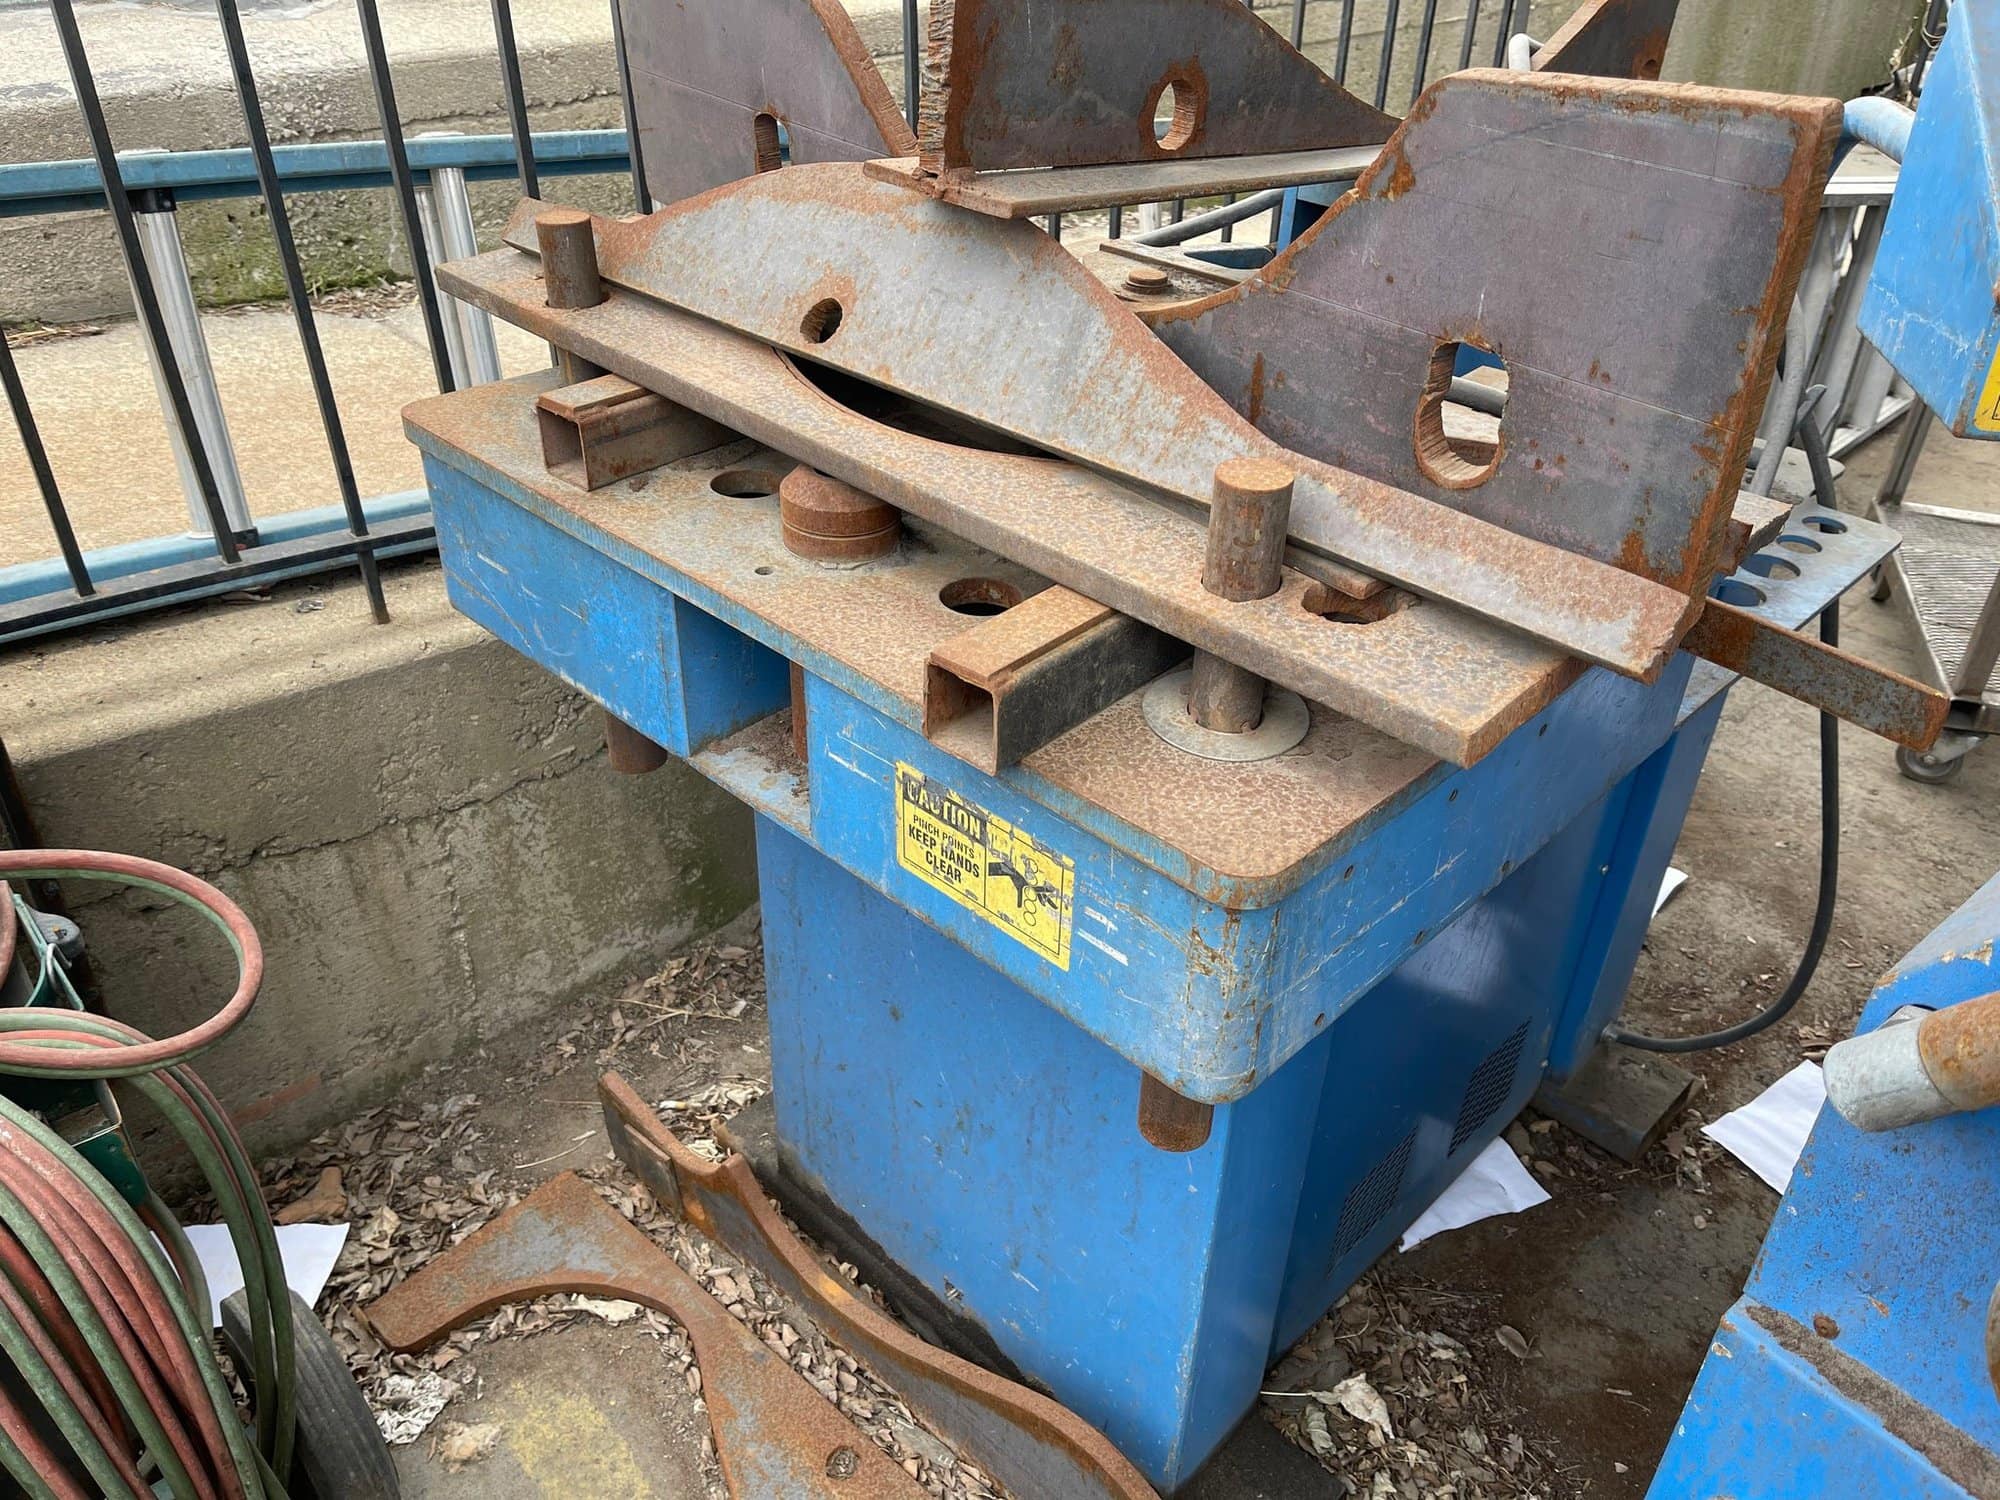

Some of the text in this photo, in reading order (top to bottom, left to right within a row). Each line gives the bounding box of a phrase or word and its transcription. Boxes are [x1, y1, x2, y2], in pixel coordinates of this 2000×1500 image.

[907, 779, 981, 839] CAUTION
[908, 824, 937, 849] KEEP
[941, 844, 980, 878] HANDS
[913, 814, 975, 859] PINCH POINTS
[926, 850, 962, 885] CLEAR
